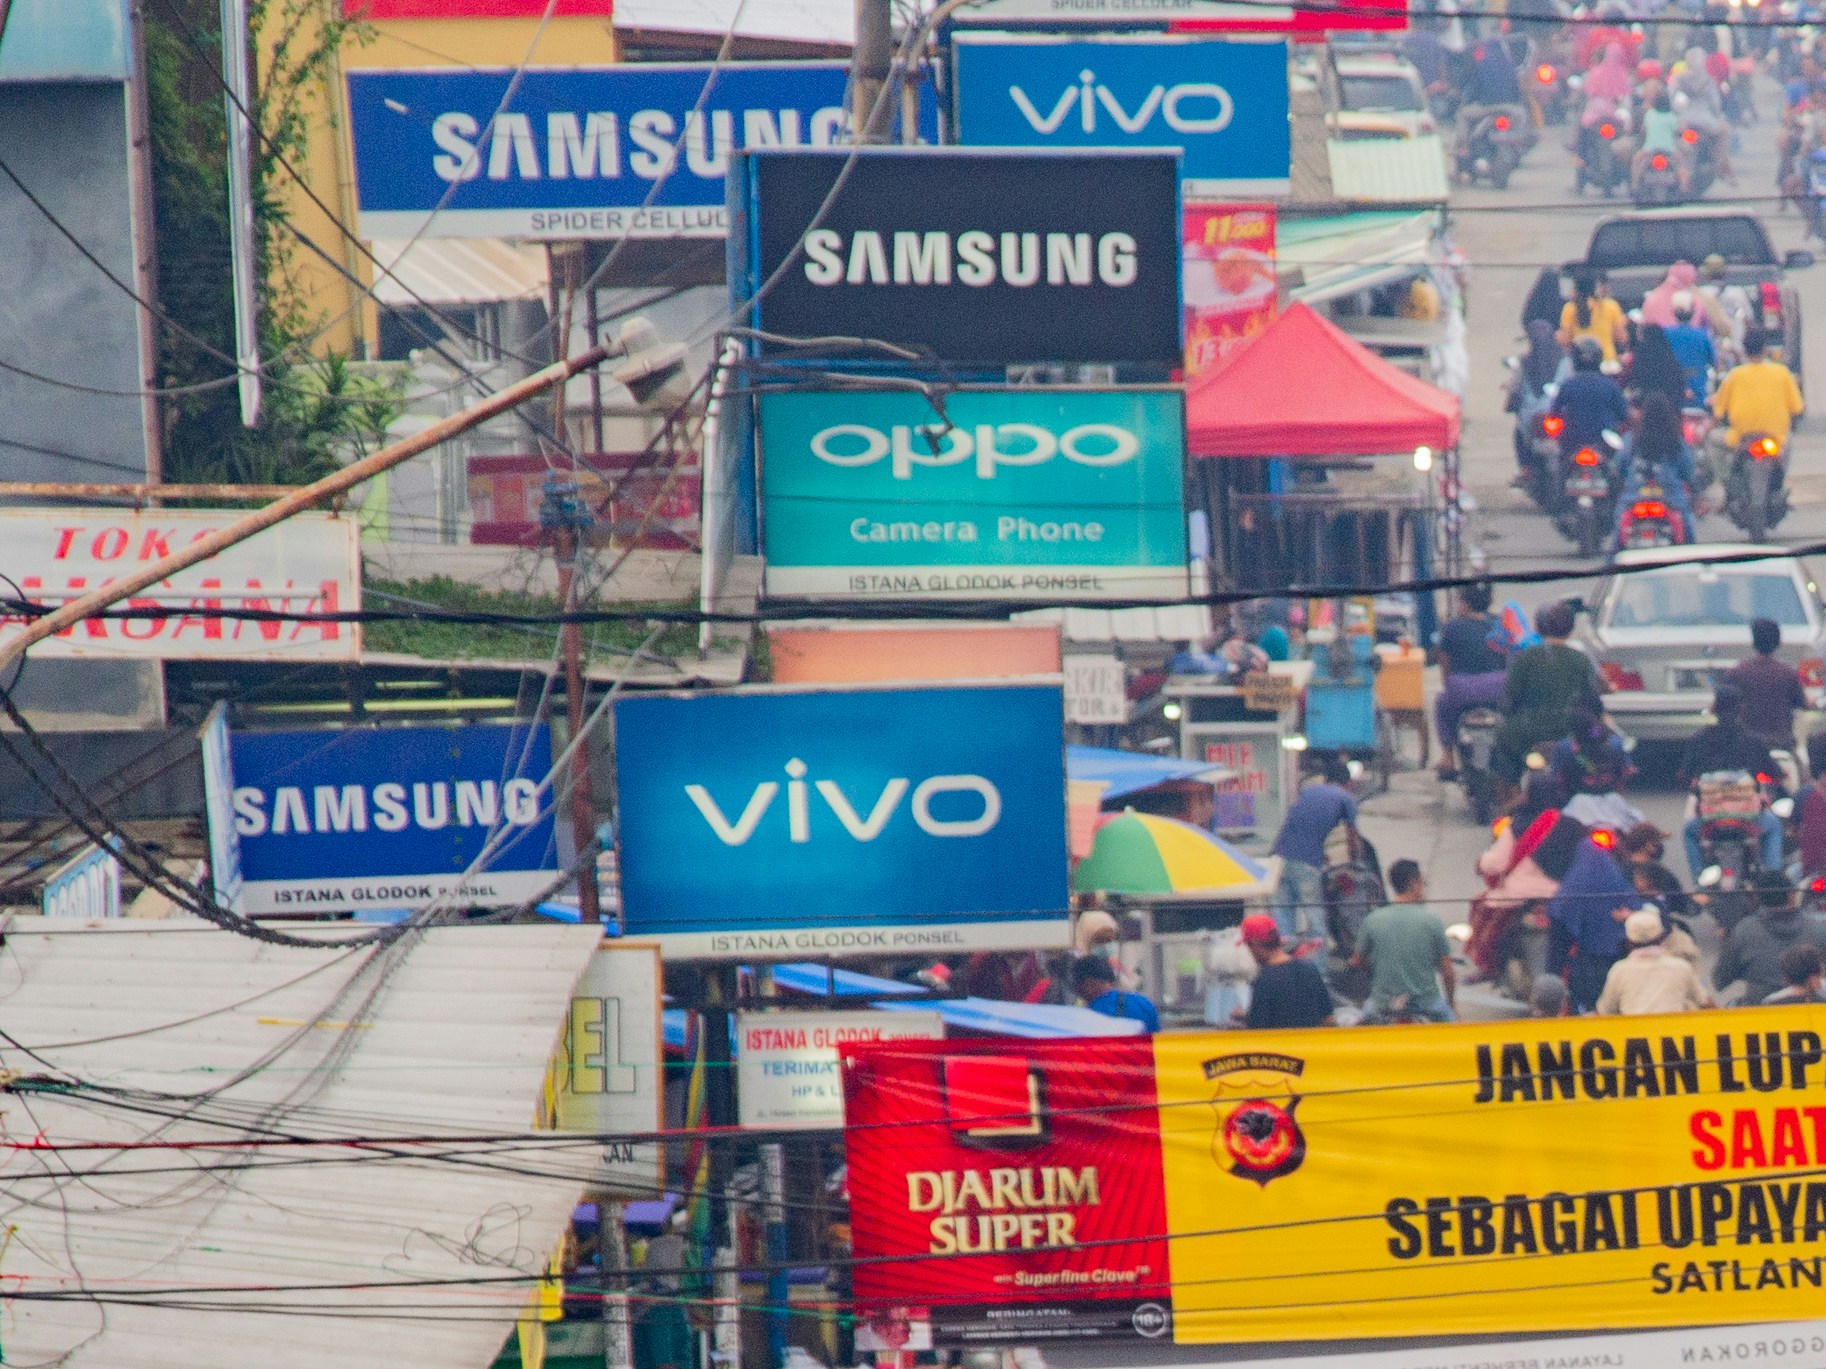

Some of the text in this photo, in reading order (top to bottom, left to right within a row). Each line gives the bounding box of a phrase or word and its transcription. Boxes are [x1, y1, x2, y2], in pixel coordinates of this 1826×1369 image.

[1009, 69, 1234, 135] vivo
[530, 211, 623, 231] SPIDER
[803, 230, 1138, 287] SAMSUNG
[850, 516, 1105, 543] Camera Phone
[849, 573, 1105, 593] ISTANA GLODOK PONSEL
[233, 777, 540, 837] SAMSUNG
[684, 756, 1001, 845] vivo
[274, 887, 346, 904] ISTANA
[352, 884, 431, 901] GLODOK
[710, 930, 965, 953] ISTANA GLODOK PONSEL
[746, 1028, 807, 1050] ISTANA
[763, 1060, 833, 1077] TERIMA
[1474, 1034, 1698, 1103] JANGAN
[792, 1085, 812, 1097] HP
[906, 1166, 1101, 1212] DJARUM
[929, 1213, 1075, 1255] SUPER
[1386, 1190, 1640, 1260] SEBAGAI
[1014, 1268, 1089, 1287] Superfine
